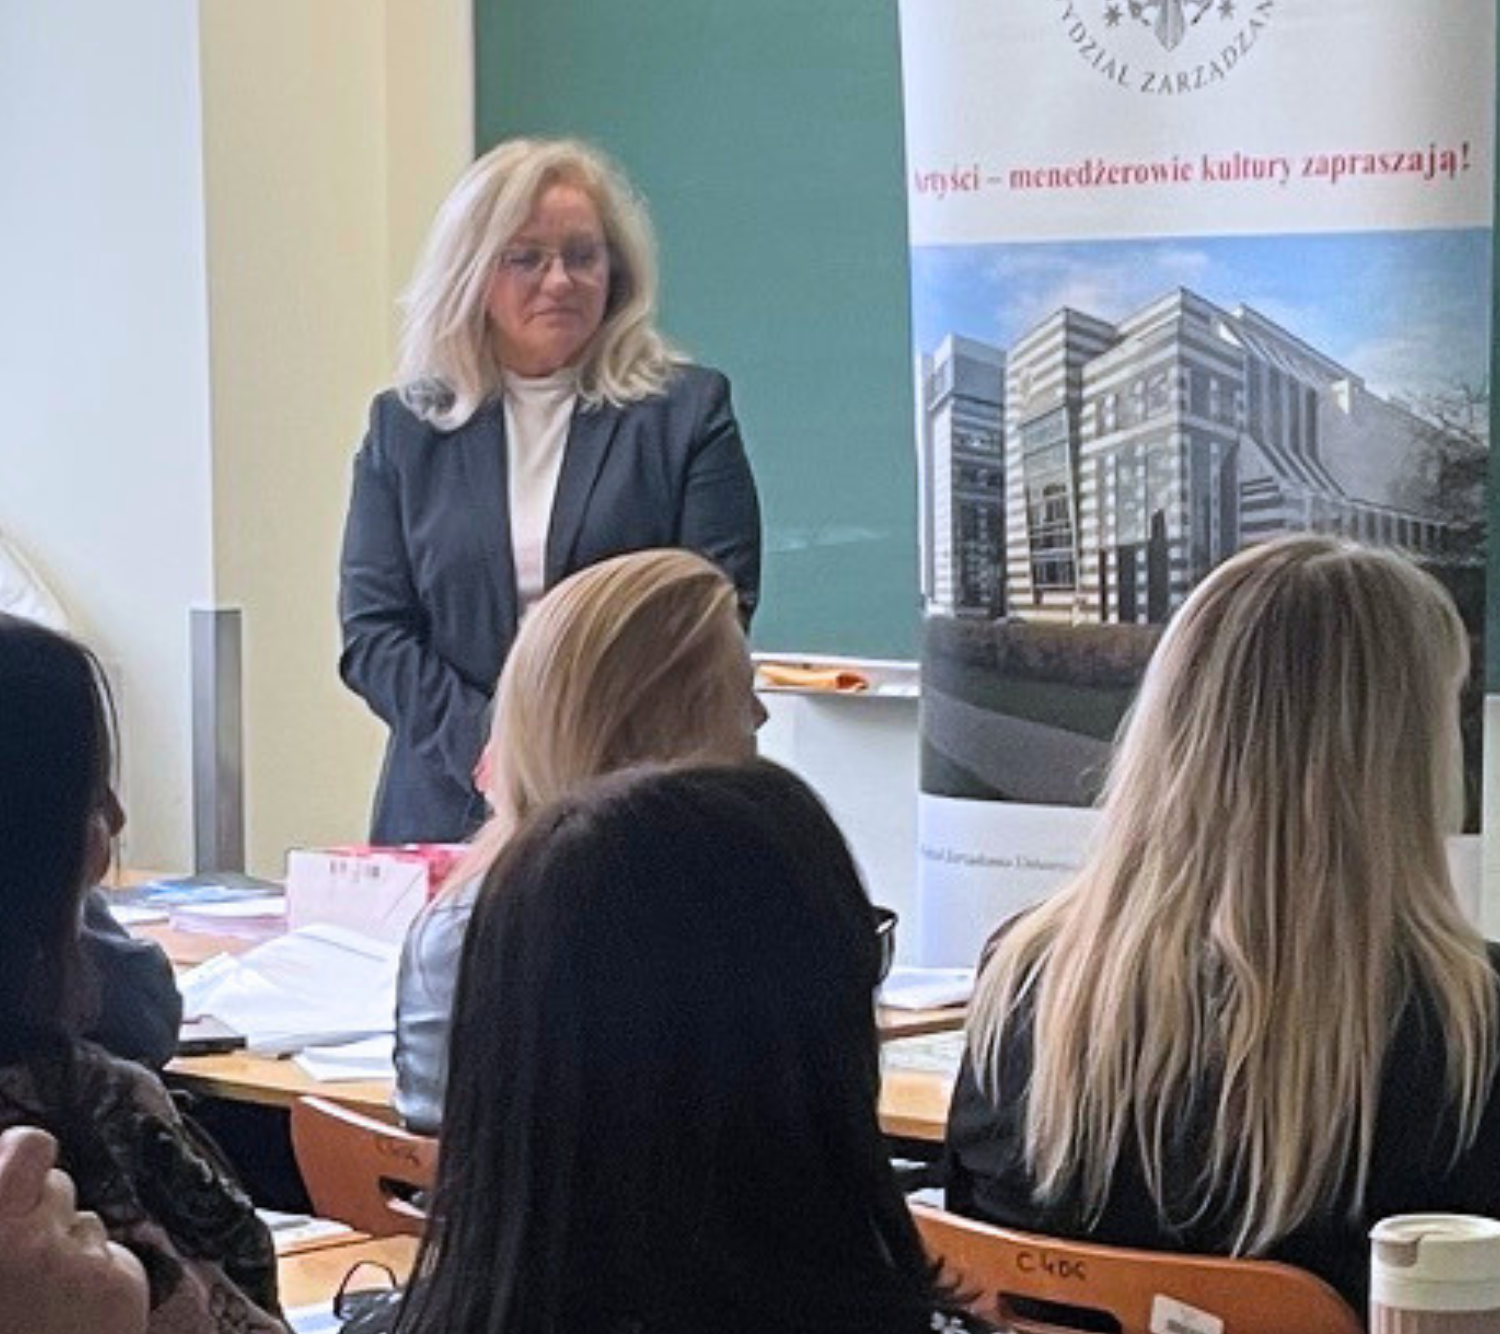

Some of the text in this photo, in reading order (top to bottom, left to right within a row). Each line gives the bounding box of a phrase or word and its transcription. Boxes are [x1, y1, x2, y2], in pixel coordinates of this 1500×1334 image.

[1009, 156, 1193, 189] menedżerowie
[1202, 152, 1290, 185] kultury
[1302, 141, 1471, 185] zapraszają!
